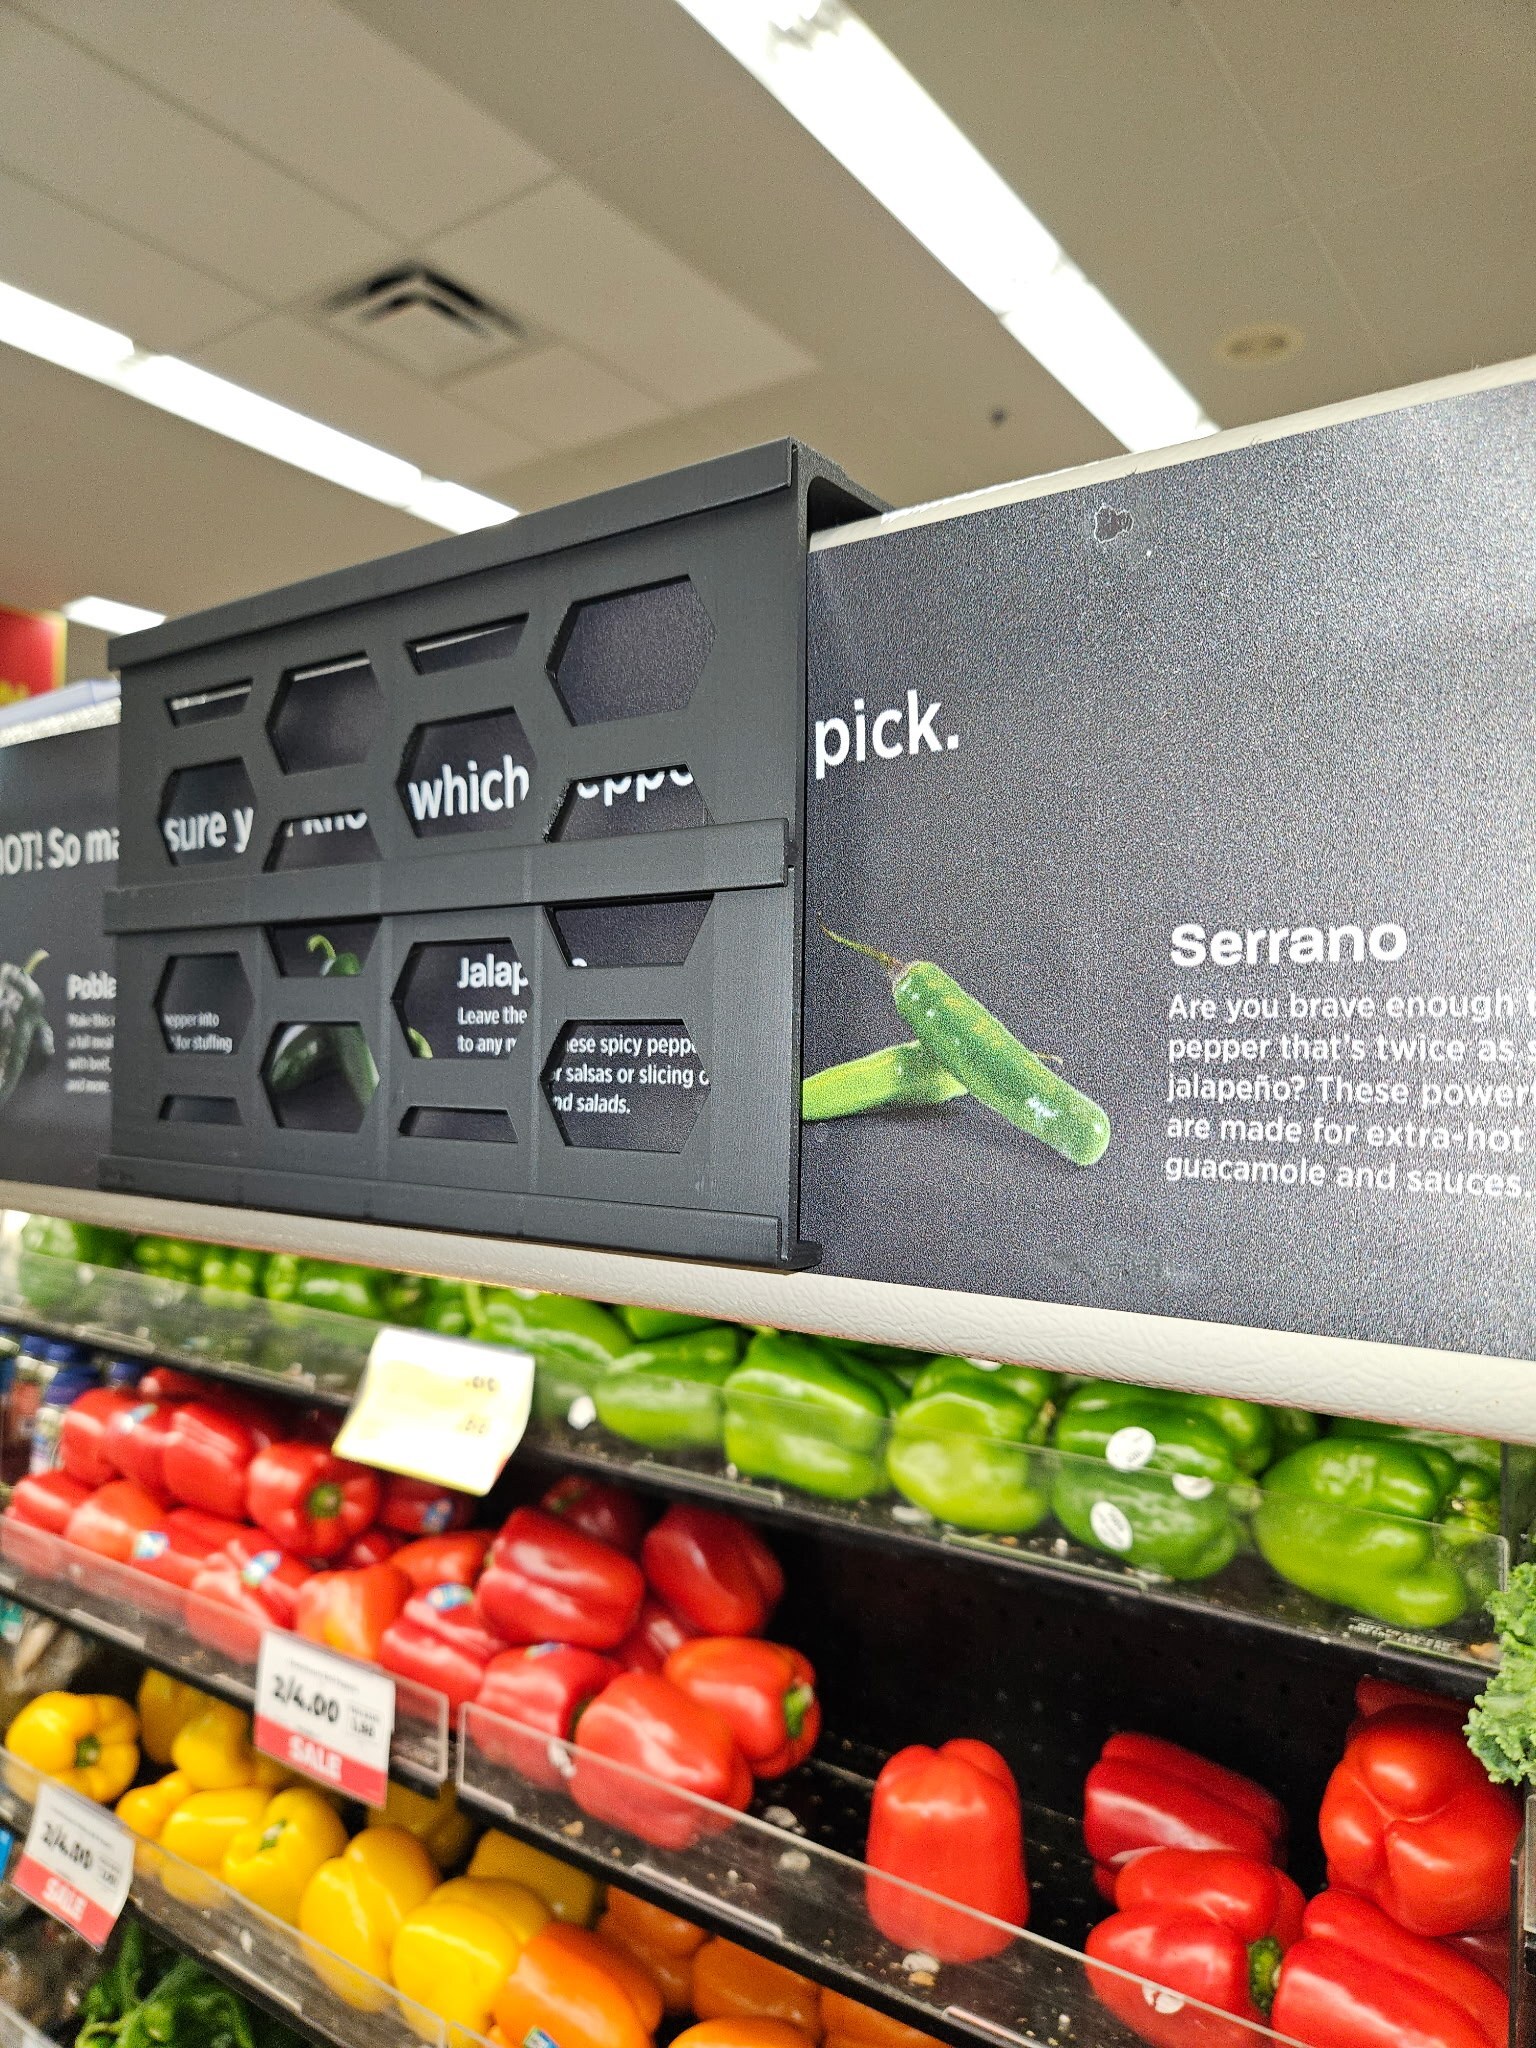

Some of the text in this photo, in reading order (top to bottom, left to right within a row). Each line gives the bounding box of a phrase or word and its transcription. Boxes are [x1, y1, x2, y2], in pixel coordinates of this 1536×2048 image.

[47, 826, 81, 869] So
[163, 811, 228, 853] sure
[232, 806, 254, 854] y
[407, 753, 530, 820] which
[815, 689, 959, 780] pick.
[1170, 923, 1408, 967] Serrano
[457, 1004, 528, 1026] Leave the
[1168, 993, 1217, 1020] Are
[1227, 998, 1279, 1024] you
[1290, 992, 1376, 1020] brave
[1386, 988, 1514, 1022] enough
[457, 1034, 474, 1053] to
[475, 1036, 503, 1056] any
[566, 1036, 597, 1054] ese
[600, 1033, 643, 1057] spicy
[1168, 1037, 1271, 1064] pepper
[1281, 1033, 1366, 1062] that's
[1376, 1033, 1466, 1062] twice
[1477, 1039, 1515, 1062] as
[565, 1063, 613, 1084] salsas
[617, 1067, 635, 1084] or
[639, 1064, 694, 1089] slicing
[1167, 1072, 1306, 1104] jalapeño?
[1316, 1075, 1410, 1104] These
[576, 1092, 631, 1115] salads.
[1166, 1114, 1525, 1152] are made for extra-hot
[1164, 1156, 1532, 1199] guacamole and sauces.
[272, 1673, 340, 1723] 2/4.00
[288, 1734, 343, 1782] SALE
